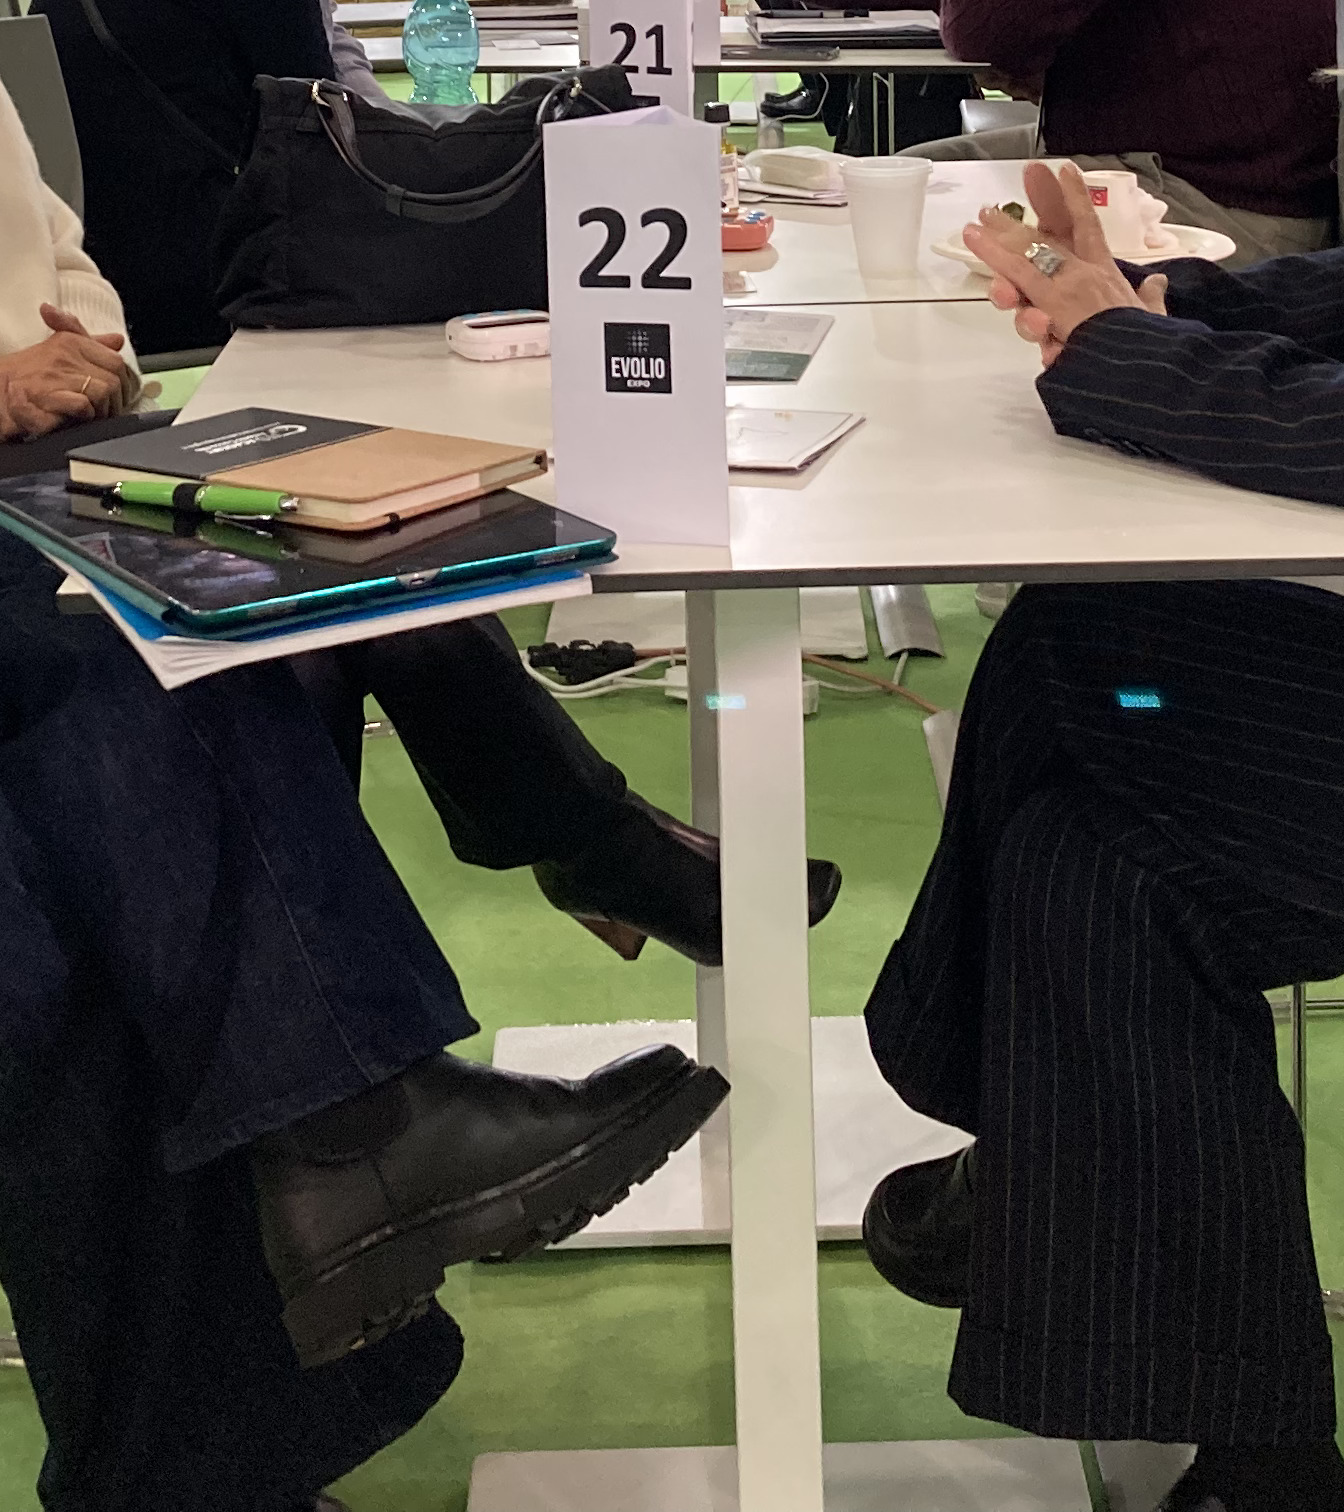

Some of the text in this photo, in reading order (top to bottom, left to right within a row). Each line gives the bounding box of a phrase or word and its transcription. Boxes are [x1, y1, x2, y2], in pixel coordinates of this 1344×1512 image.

[609, 22, 673, 76] 21
[578, 207, 692, 290] 22
[610, 356, 666, 379] EVOLIO
